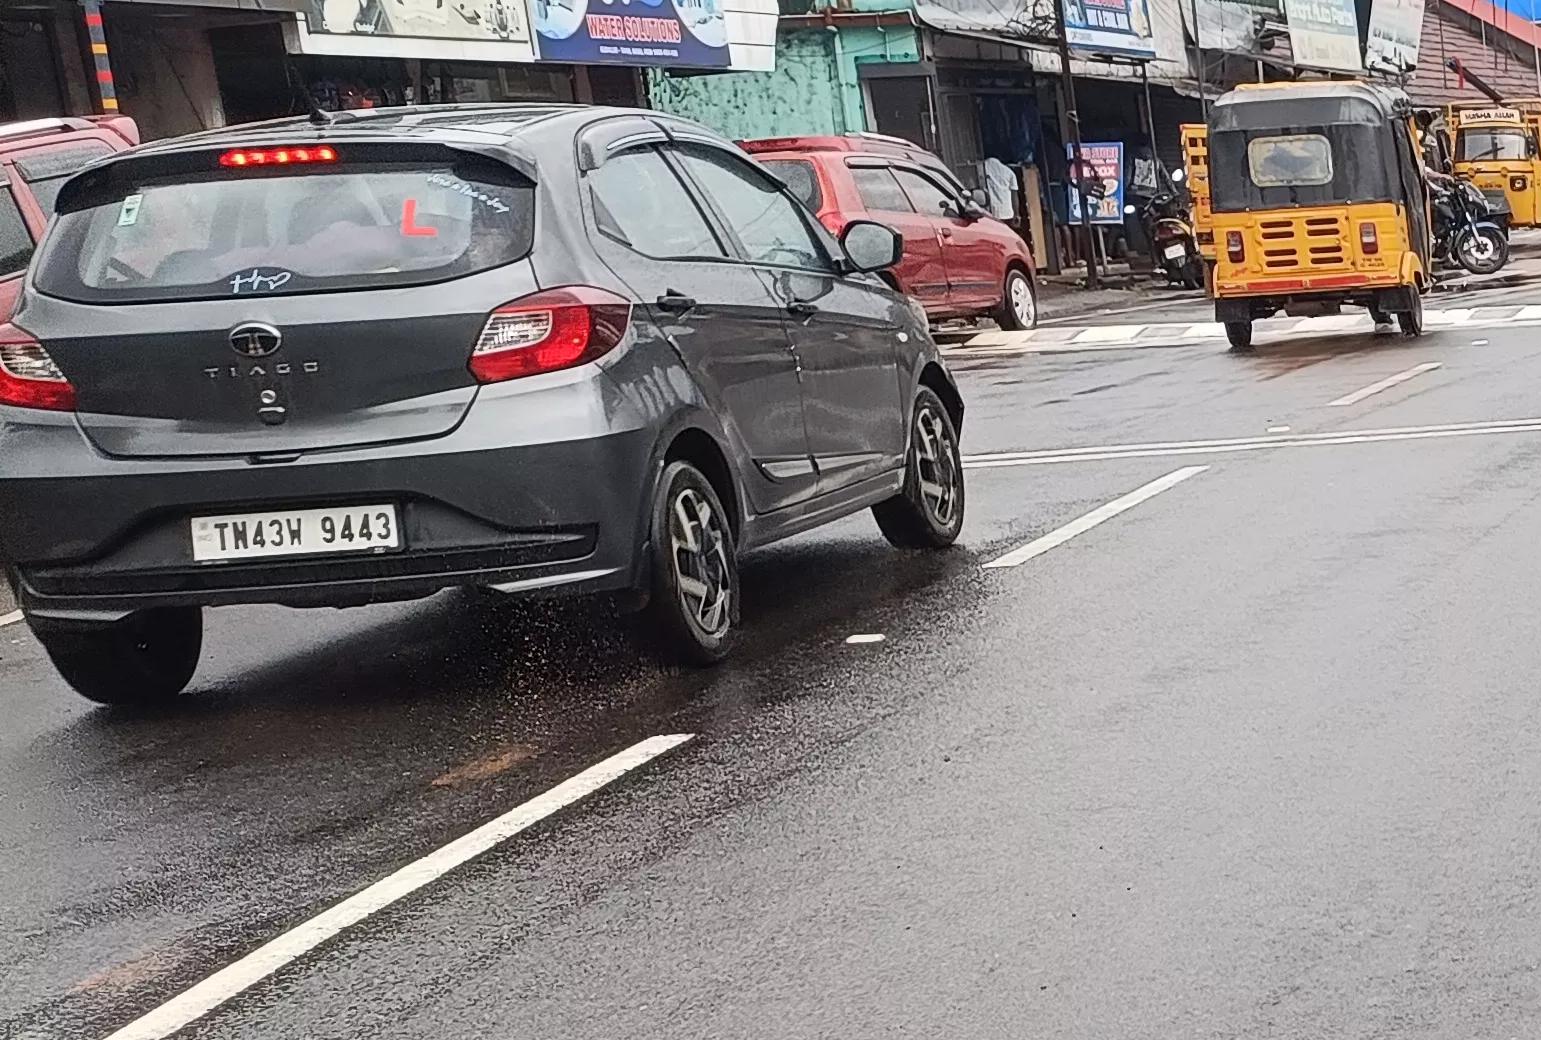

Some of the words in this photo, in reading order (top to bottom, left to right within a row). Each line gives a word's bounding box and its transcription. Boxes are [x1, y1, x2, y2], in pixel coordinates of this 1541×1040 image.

[586, 14, 625, 40] WATER
[624, 16, 681, 43] SOLUTIONS
[402, 198, 437, 236] L
[203, 361, 319, 378] TIAGO
[213, 517, 302, 551] TN43W
[320, 512, 391, 544] 9443
